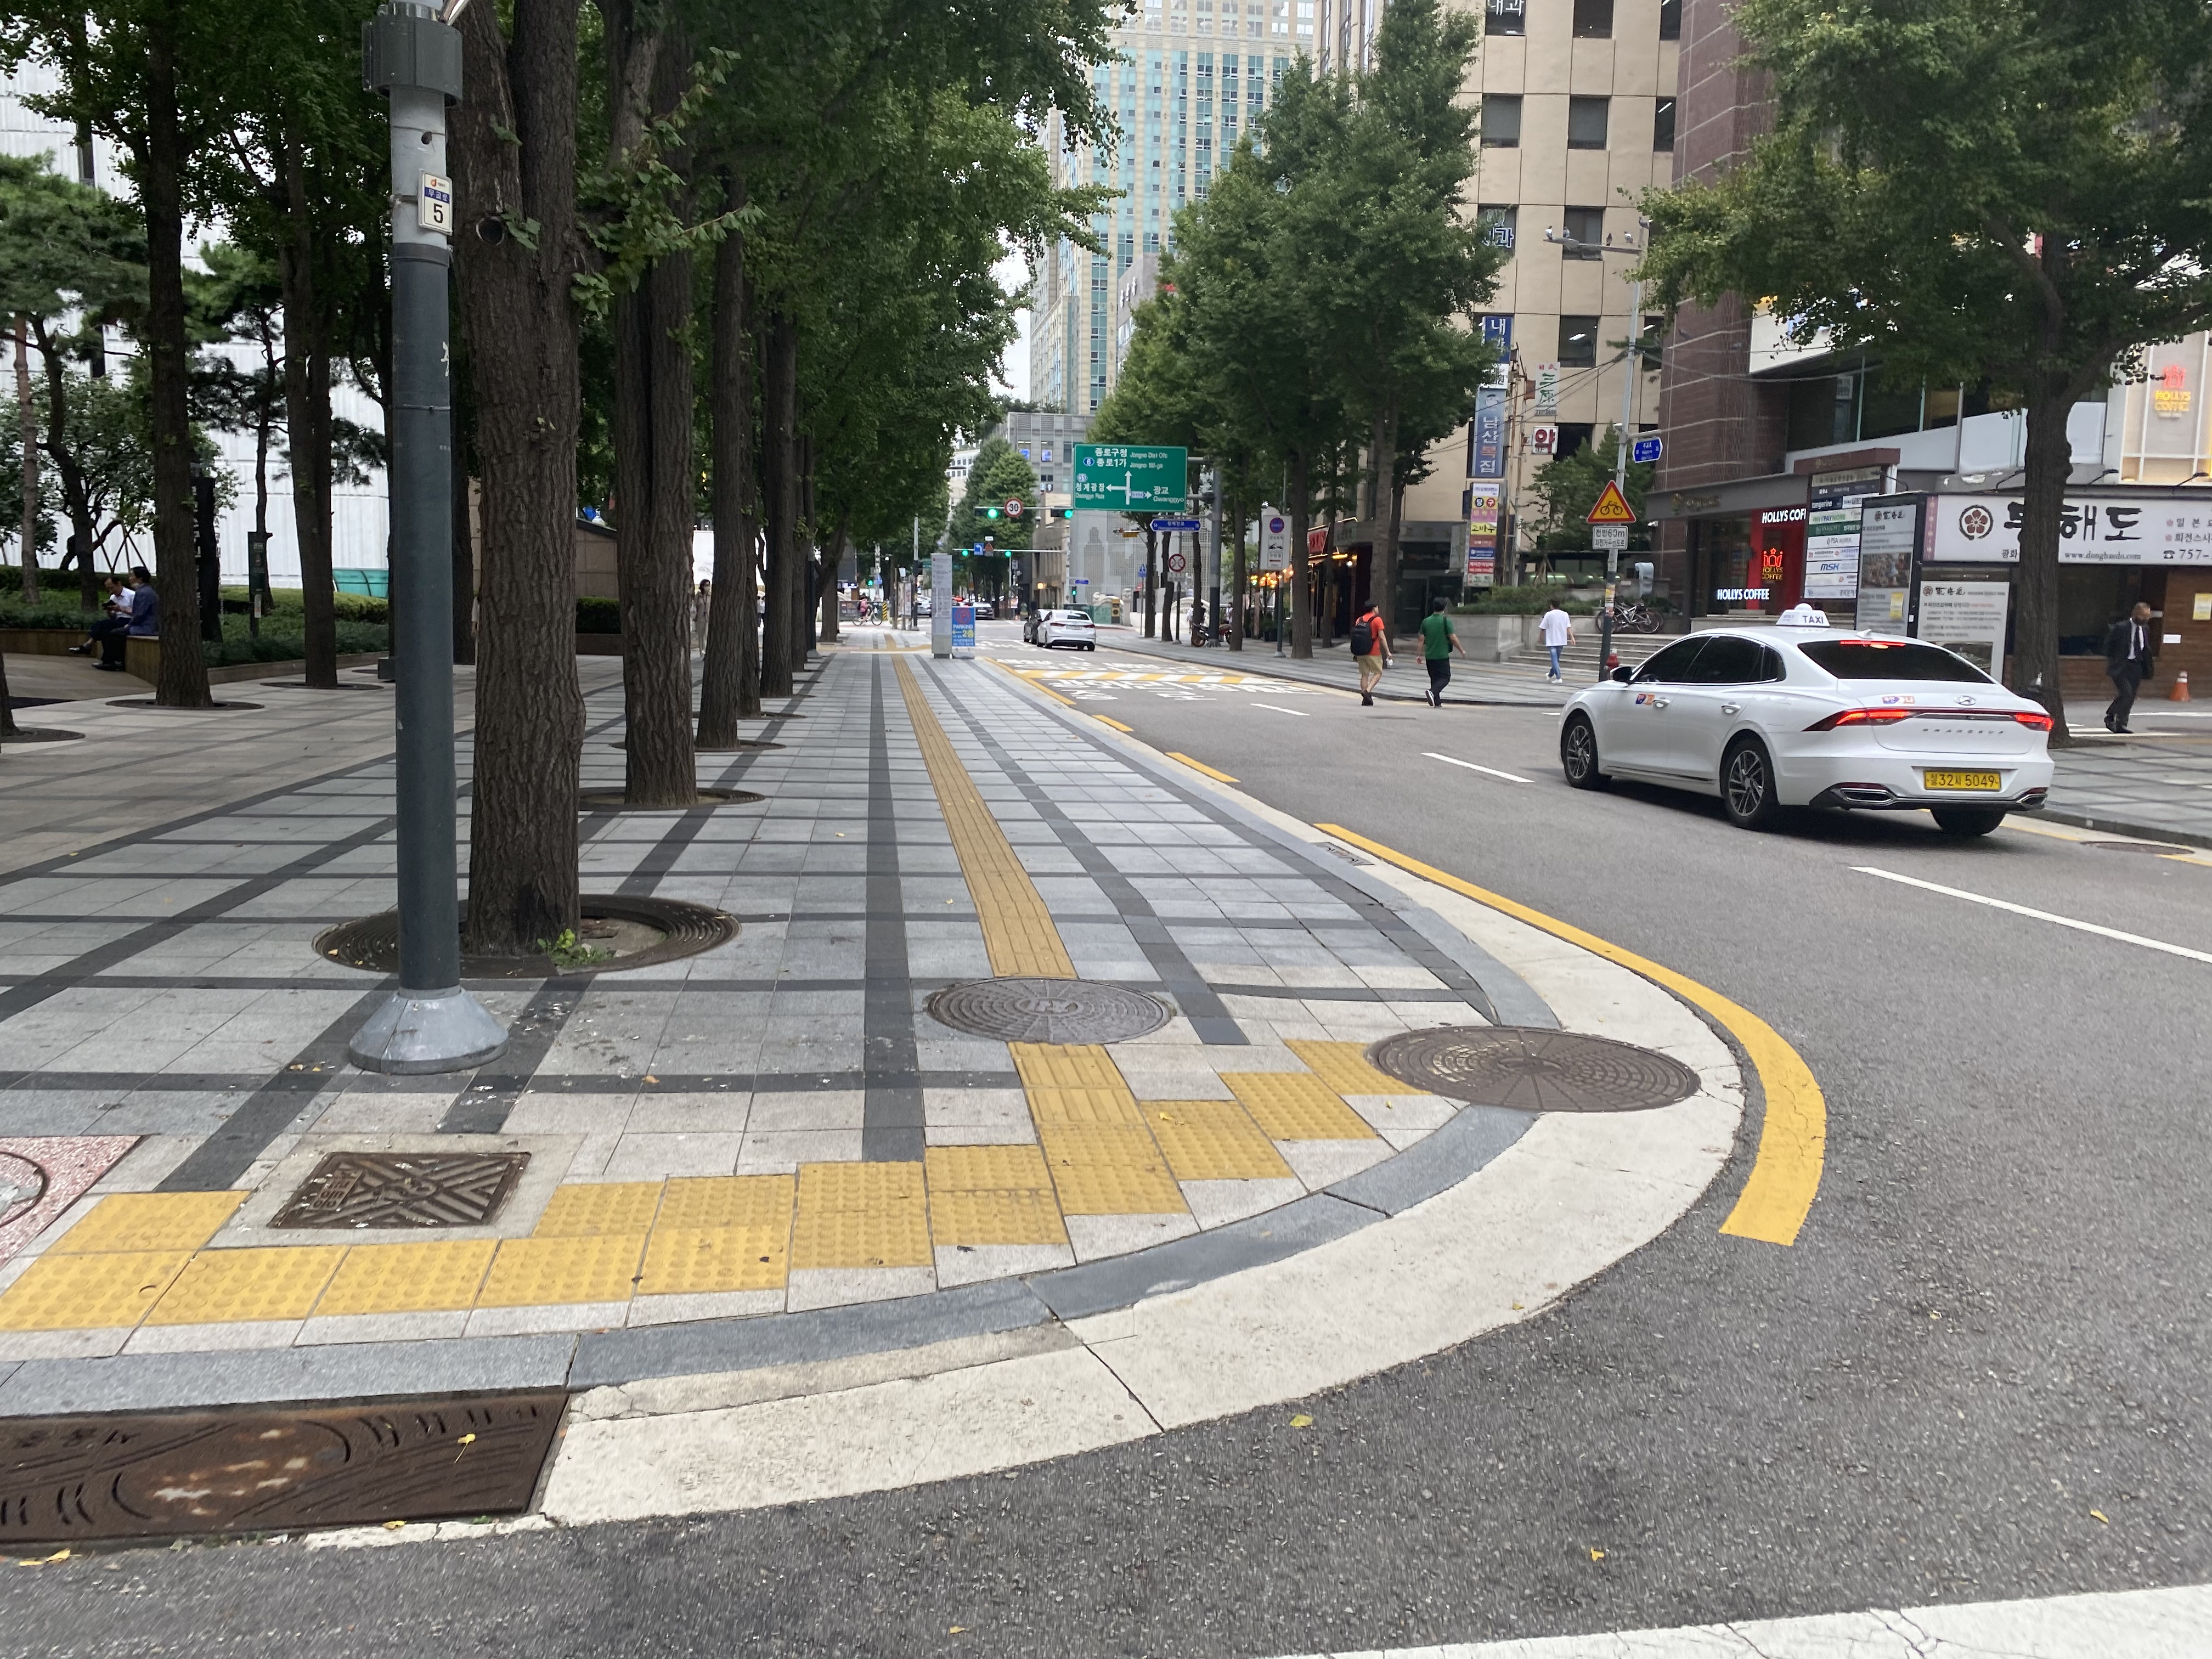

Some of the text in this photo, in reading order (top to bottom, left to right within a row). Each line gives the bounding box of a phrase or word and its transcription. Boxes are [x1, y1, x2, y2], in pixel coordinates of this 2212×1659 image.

[433, 203, 443, 223] 5
[2155, 390, 2191, 401] HOLLYS
[1535, 429, 1555, 455] 약
[1095, 448, 1127, 457] 종로구청
[1097, 459, 1126, 467] 종로1가
[1076, 483, 1104, 492] 청계광장
[1009, 503, 1019, 512] 30
[1762, 510, 1788, 523] HOLLYS
[2064, 551, 2141, 561] www.donghaedo.com
[2180, 549, 2212, 560] 757-
[1820, 563, 1839, 571] MSK
[1717, 588, 1770, 600] HOLLYS COFFEE
[1802, 615, 1824, 624] TAXI
[1965, 775, 1995, 787] 5049
